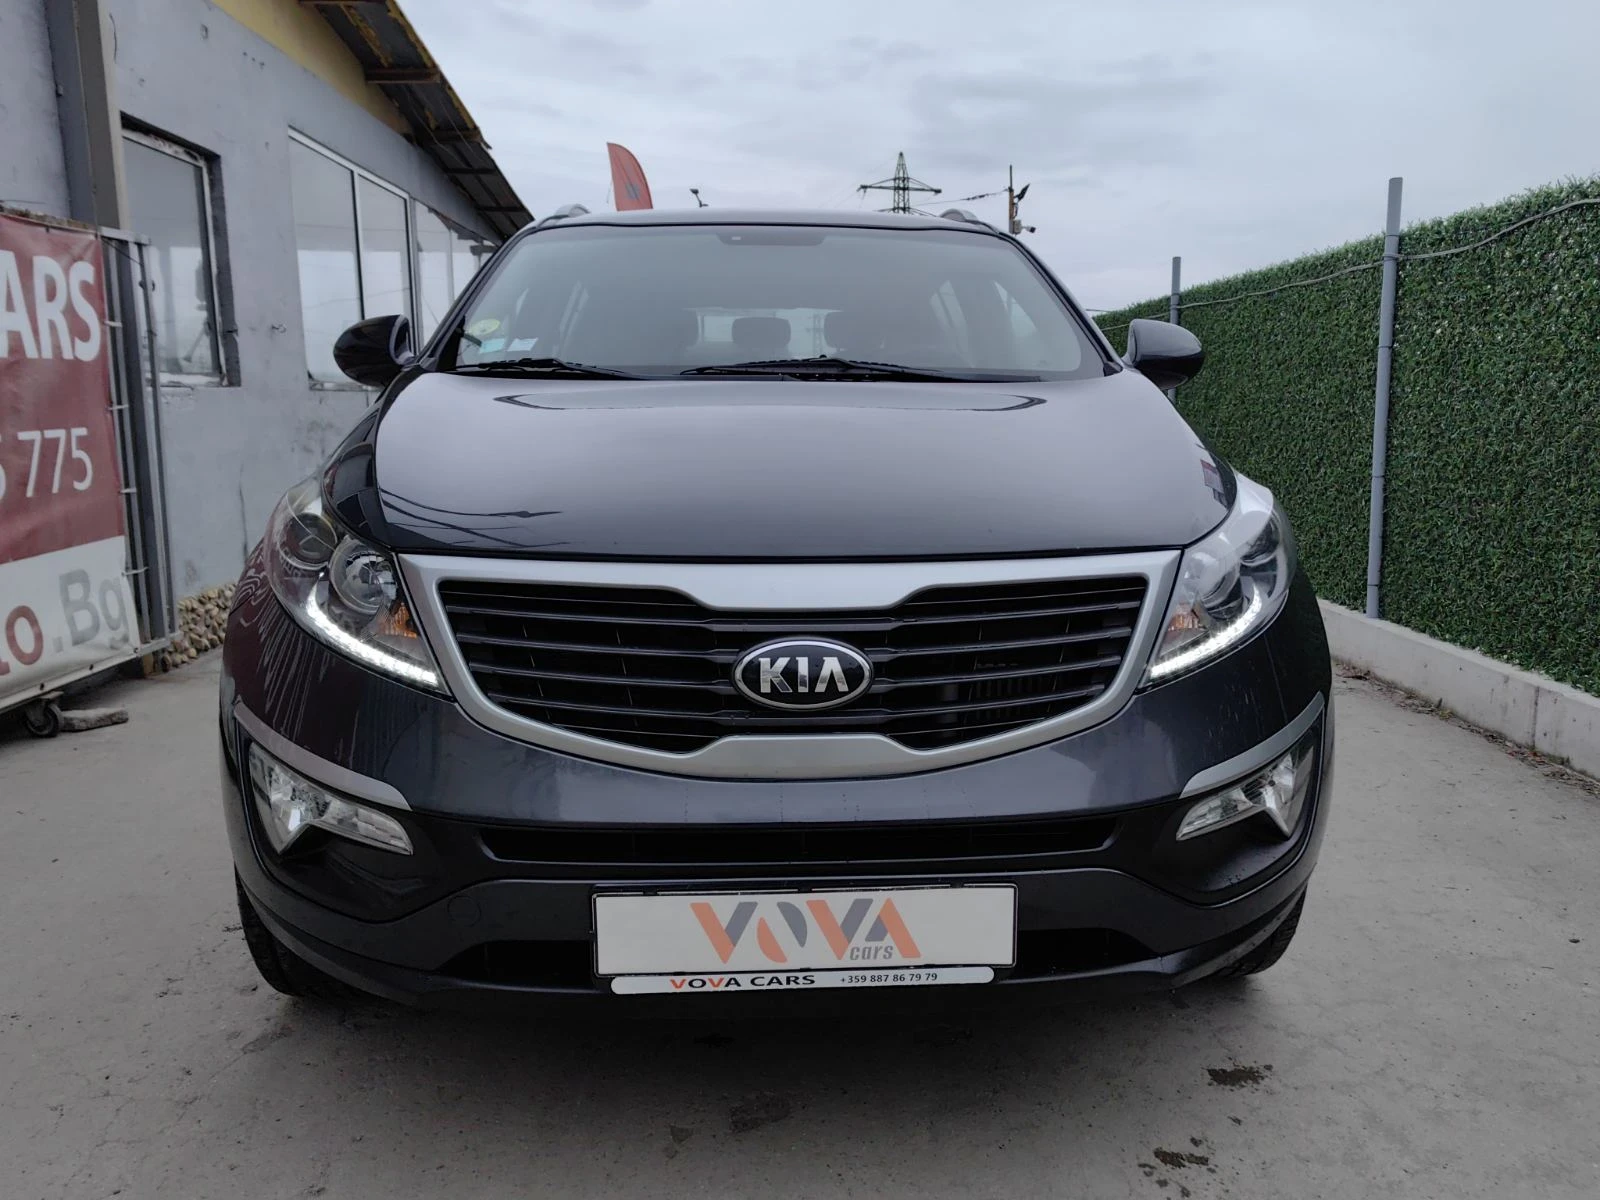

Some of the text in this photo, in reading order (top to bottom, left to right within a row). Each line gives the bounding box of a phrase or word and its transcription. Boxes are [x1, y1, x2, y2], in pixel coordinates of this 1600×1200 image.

[17, 427, 94, 498] 775
[758, 656, 849, 694] KIA
[690, 897, 922, 965] VOVA
[849, 944, 894, 961] cars
[670, 972, 938, 990] VOVA CARS +359 887 86 79 79
